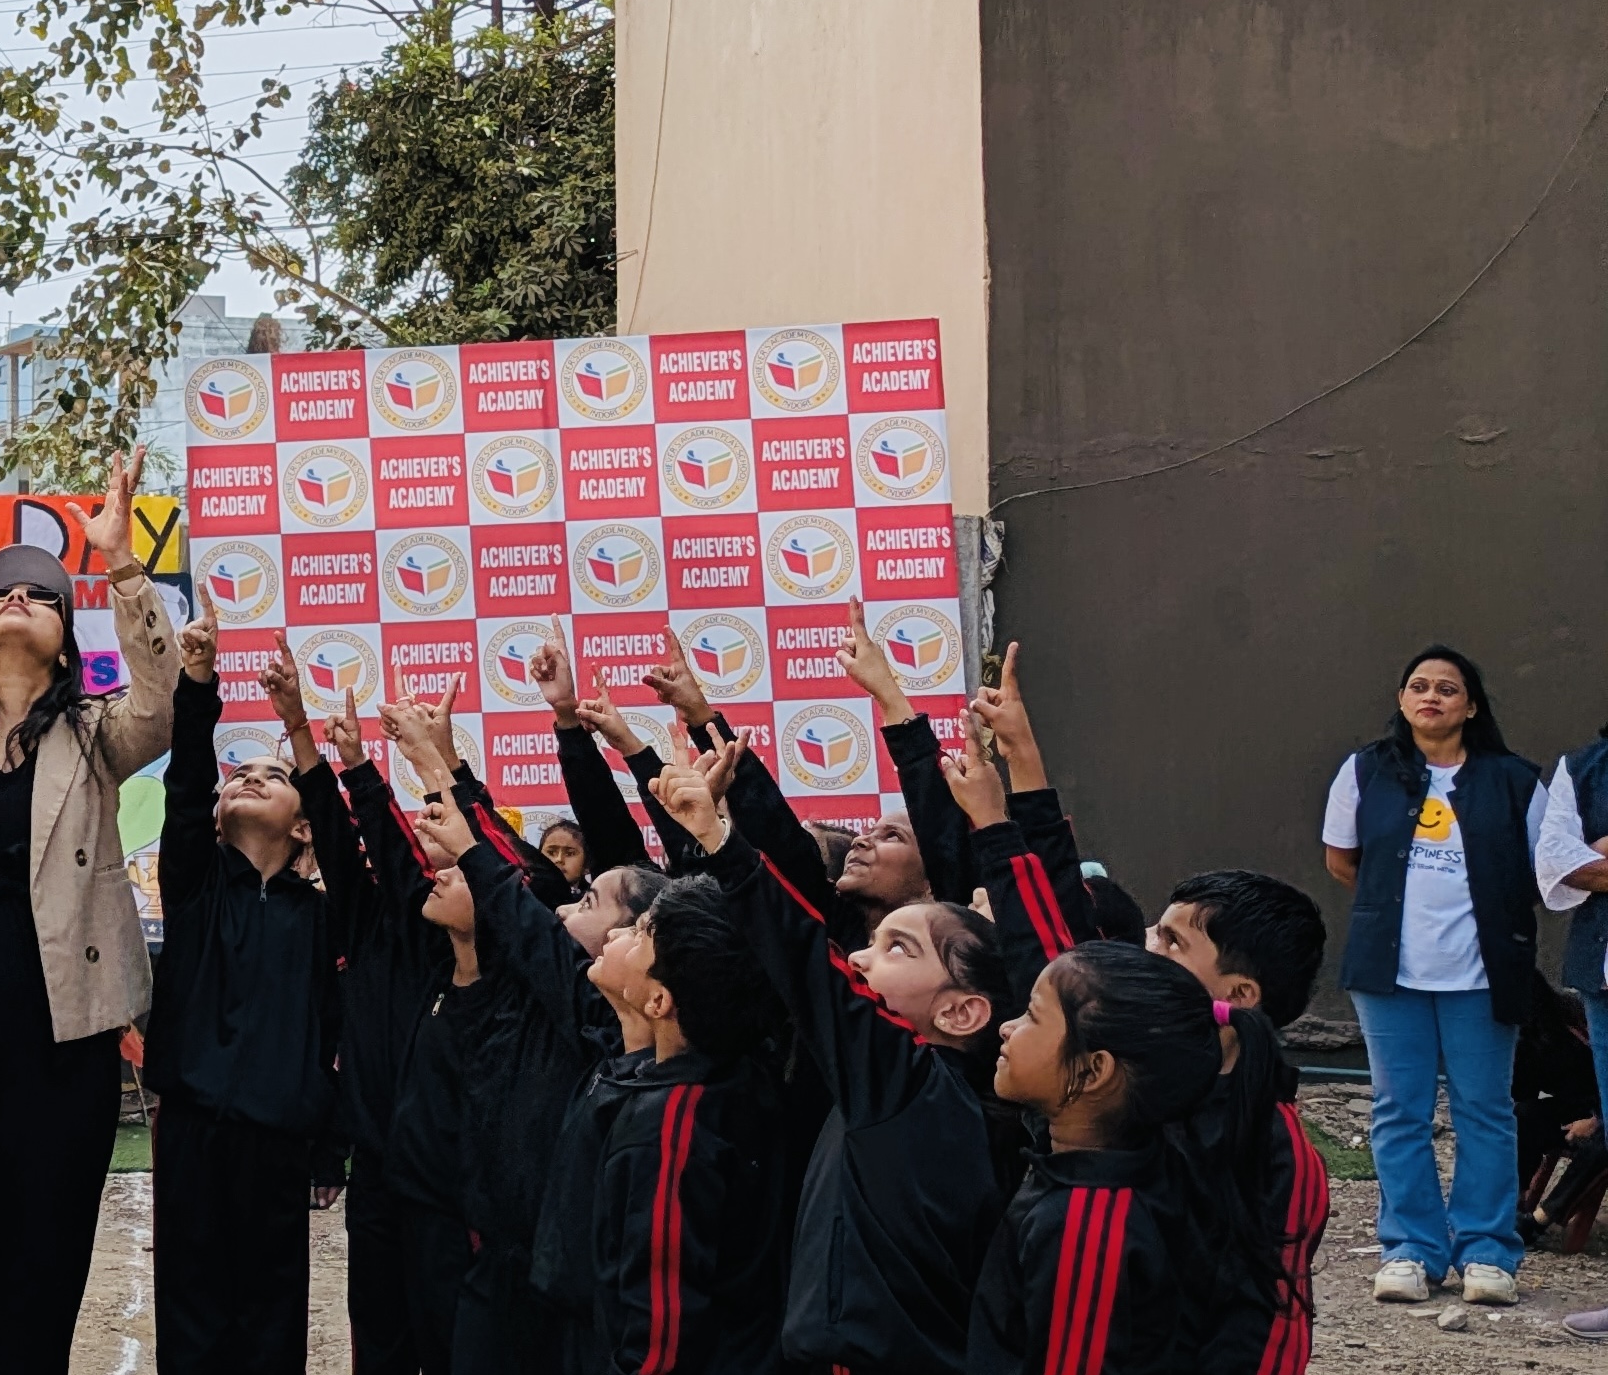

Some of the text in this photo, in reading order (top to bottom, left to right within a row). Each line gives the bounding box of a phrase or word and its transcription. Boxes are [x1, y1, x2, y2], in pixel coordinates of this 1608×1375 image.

[660, 350, 742, 373] ACHIEVER'S
[853, 339, 936, 363] ACHIEVER'S
[281, 369, 360, 392] ACHIEVER'S
[469, 360, 550, 383] ACHIEVER'S
[863, 369, 930, 392] ACADEMY
[479, 389, 543, 412] ACADEMY
[669, 380, 735, 402] ACADEMY
[290, 399, 354, 421] ACADEMY
[570, 447, 651, 470] ACHIEVER'S
[762, 438, 845, 461] ACHIEVER'S
[193, 466, 272, 488] ACHIEVER'S
[380, 456, 461, 479] ACHIEVER'S
[772, 468, 839, 490] ACADEMY
[390, 486, 454, 508] ACADEMY
[580, 477, 645, 499] ACADEMY
[202, 495, 266, 517] ACADEMY
[673, 536, 755, 559] ACHIEVER'S
[867, 527, 950, 550] ACHIEVER'S
[291, 553, 371, 576] ACHIEVER'S
[481, 545, 562, 568] ACHIEVER'S
[683, 566, 749, 588] ACADEMY
[877, 558, 944, 580] ACADEMY
[300, 583, 365, 605] ACADEMY
[490, 574, 556, 597] ACADEMY
[581, 634, 666, 658] ACHIEVER'S
[776, 626, 855, 650] ACHIEVER'
[390, 642, 473, 666] ACHIEVER'S
[787, 657, 847, 680] ACADEM
[502, 763, 562, 786] ACADEM
